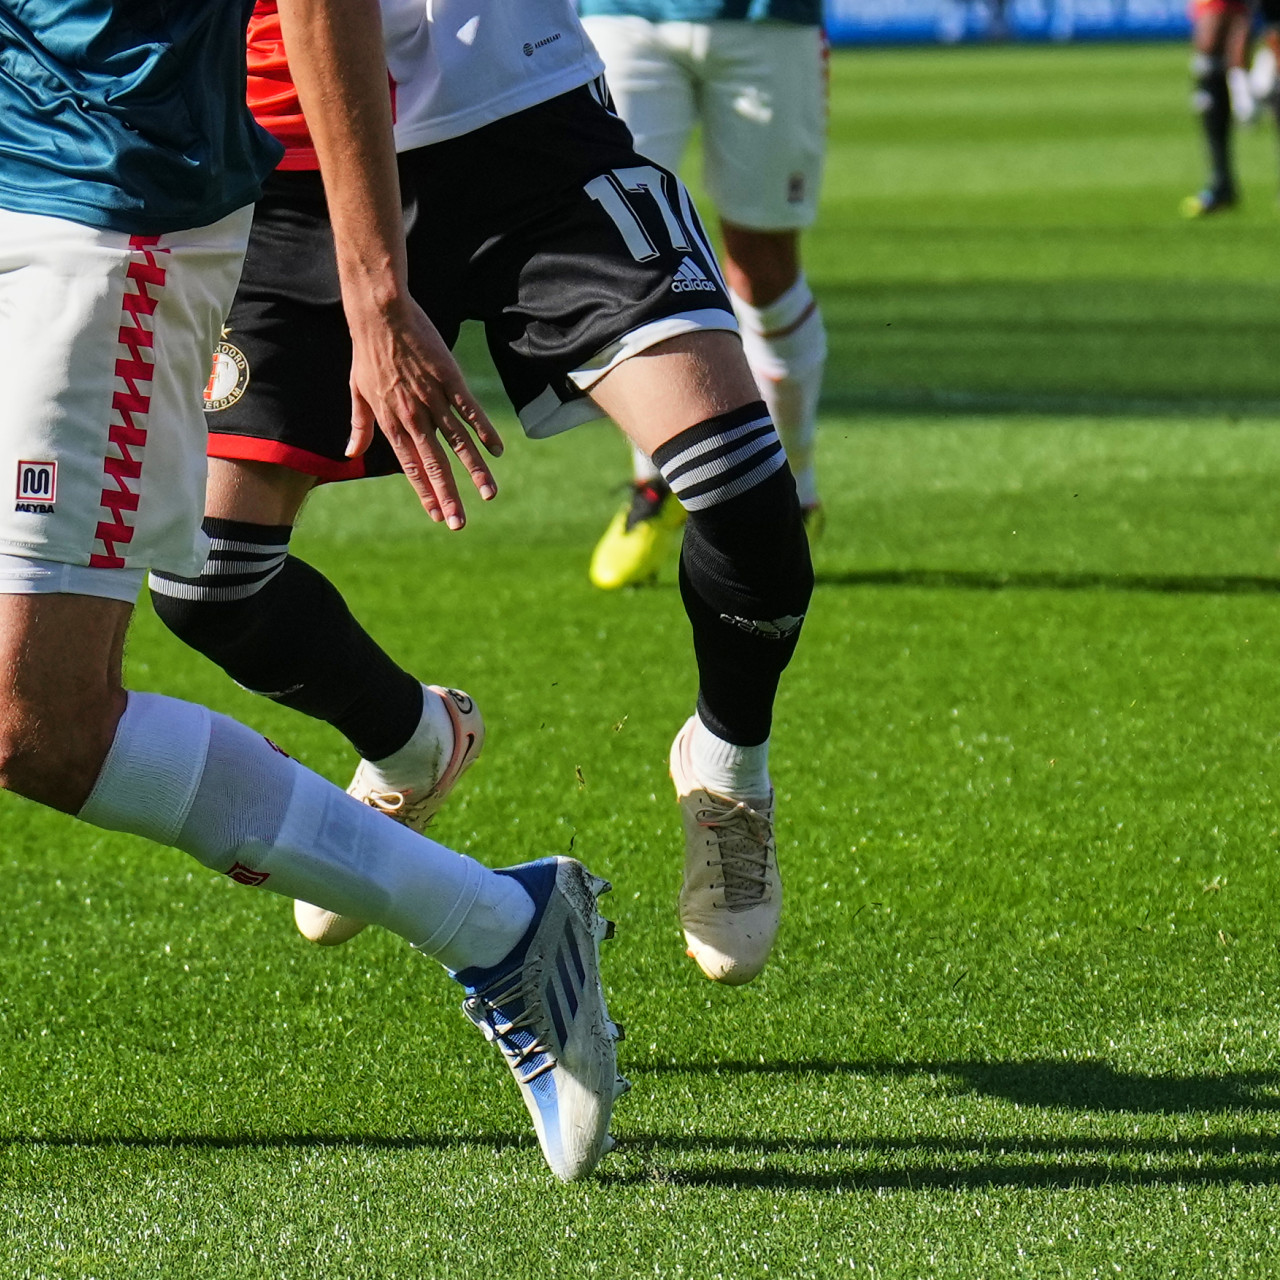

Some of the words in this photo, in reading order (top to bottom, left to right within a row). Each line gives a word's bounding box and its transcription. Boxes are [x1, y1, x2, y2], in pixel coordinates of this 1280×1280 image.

[583, 165, 693, 263] 17
[671, 278, 716, 293] adidas
[14, 502, 55, 514] MEYBA
